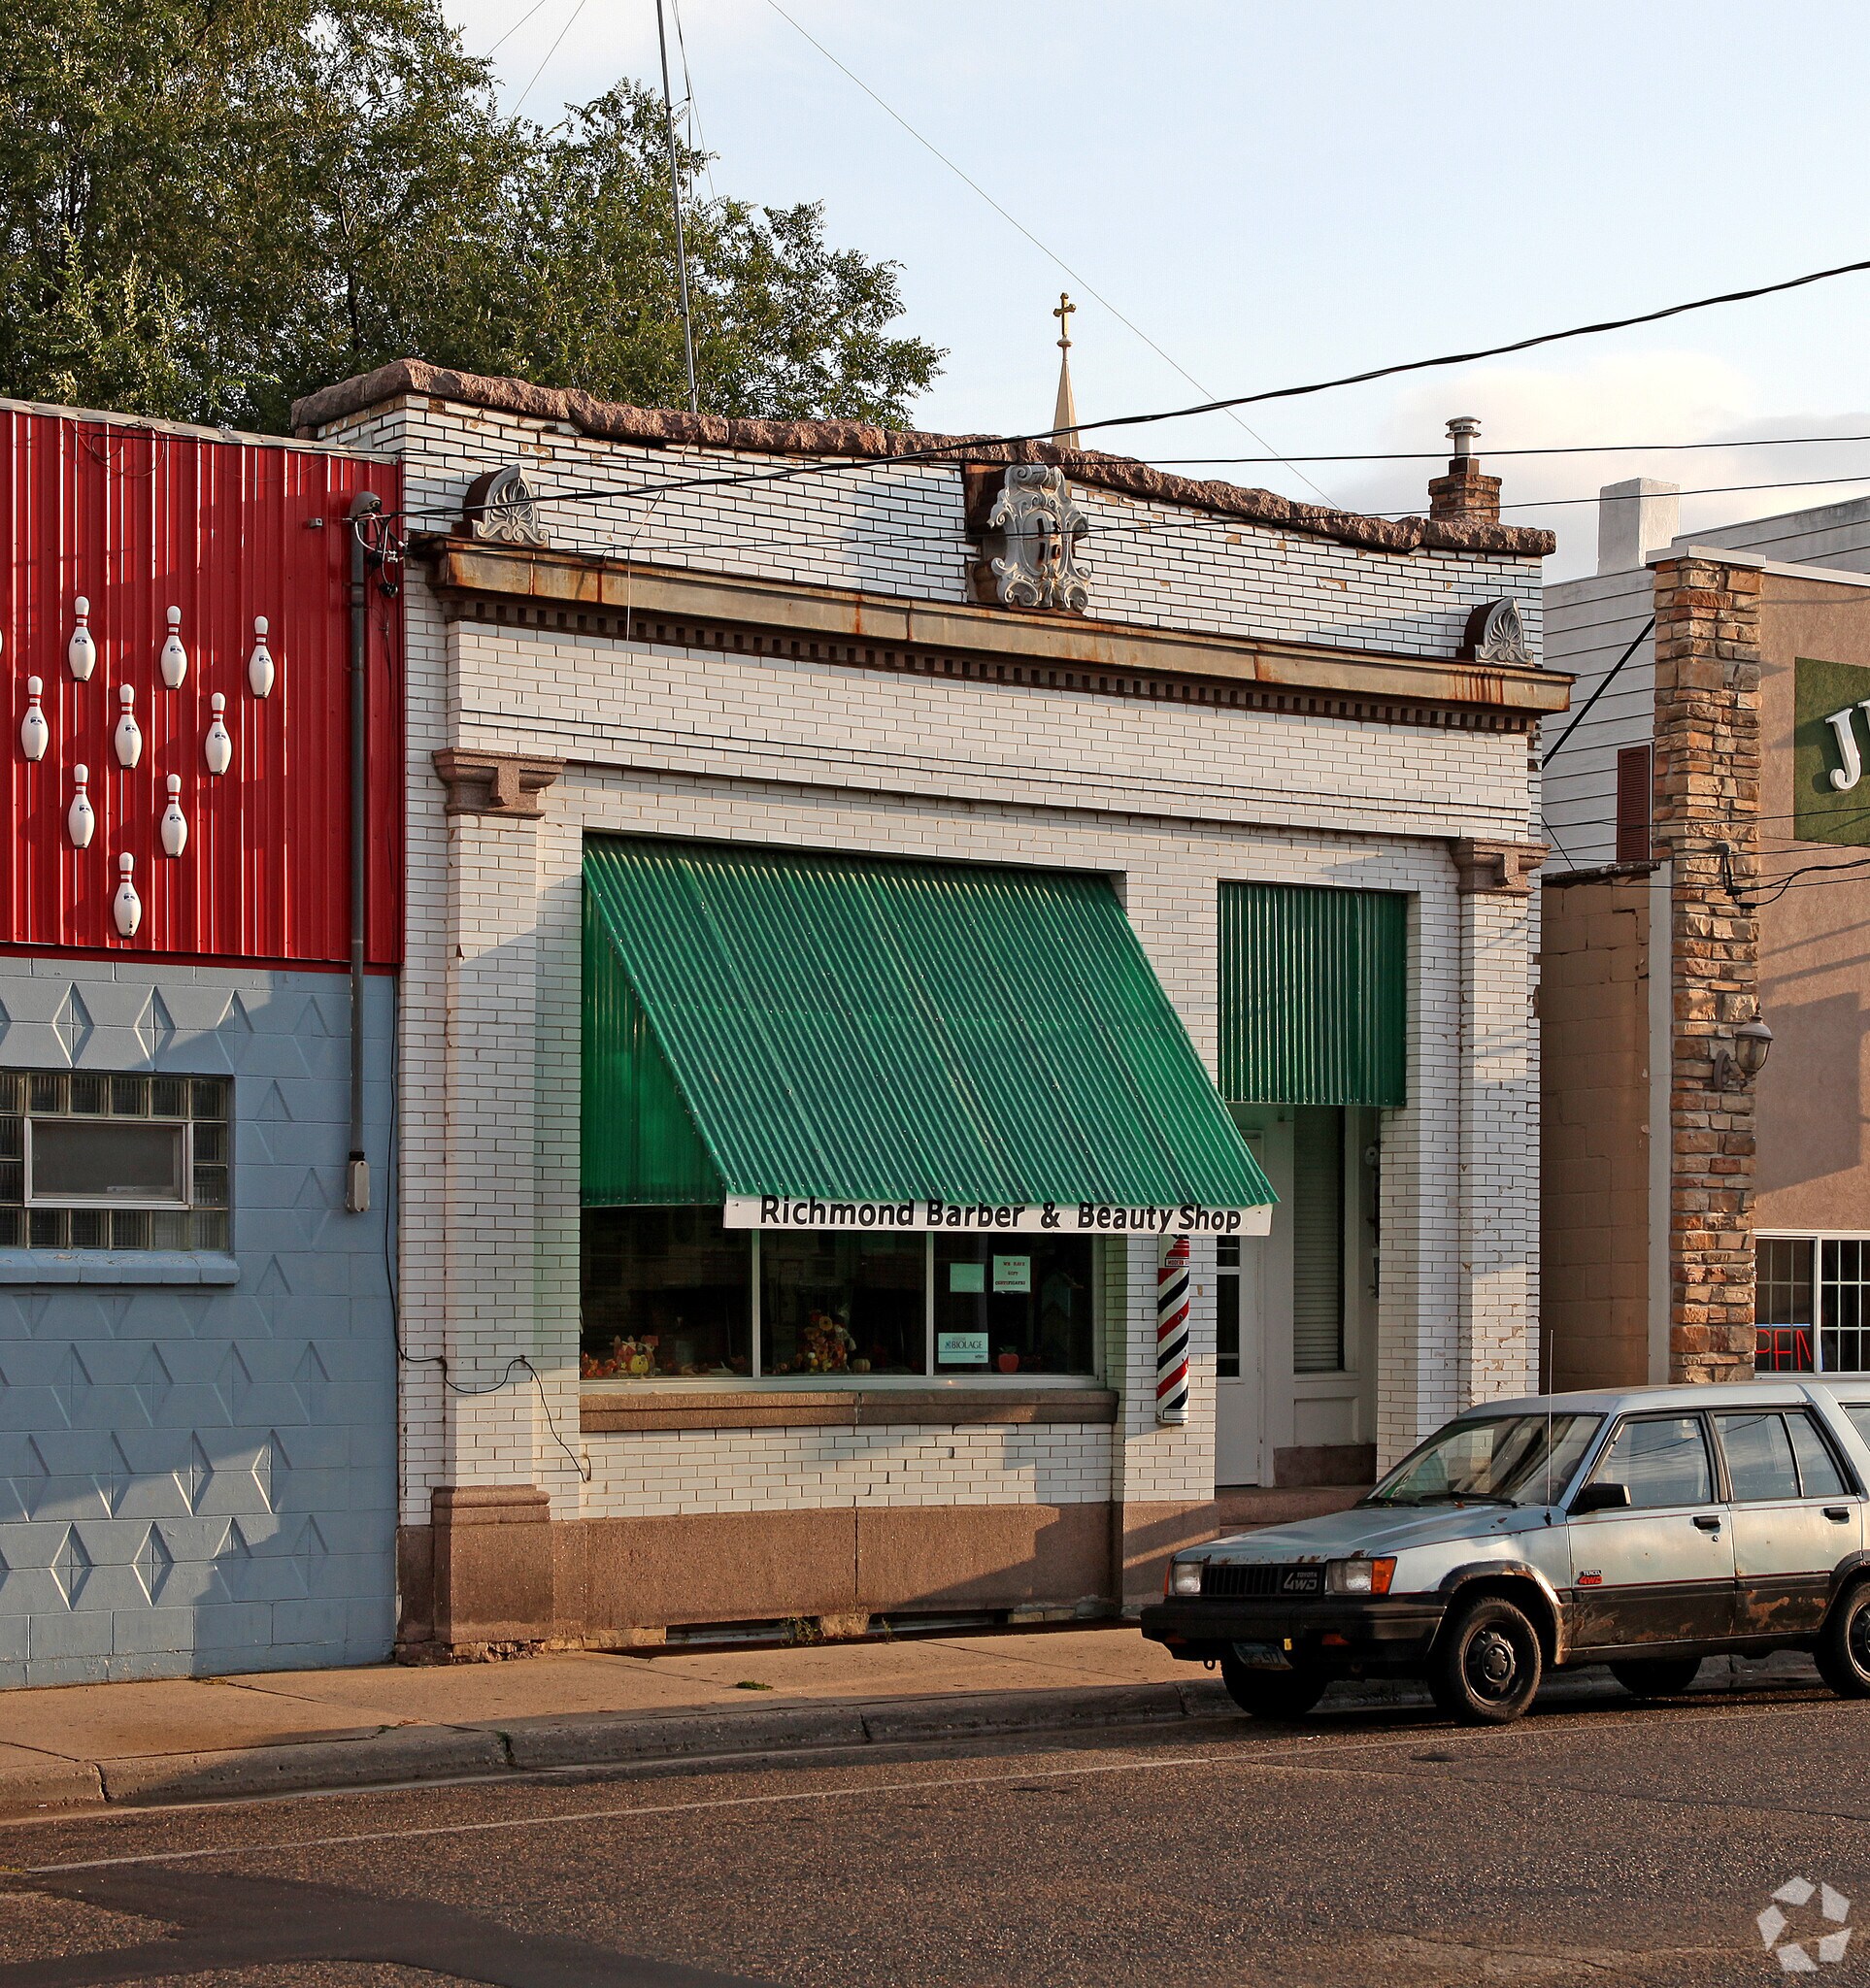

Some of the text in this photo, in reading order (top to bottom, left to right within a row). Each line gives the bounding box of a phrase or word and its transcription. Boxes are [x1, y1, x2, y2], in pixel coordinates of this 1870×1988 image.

[760, 1194, 1242, 1234] Richmond Barber & Beauty Shop
[952, 1340, 983, 1349] BIOLAGE
[1283, 1572, 1318, 1591] 4WD
[1578, 1575, 1603, 1585] 4WD
